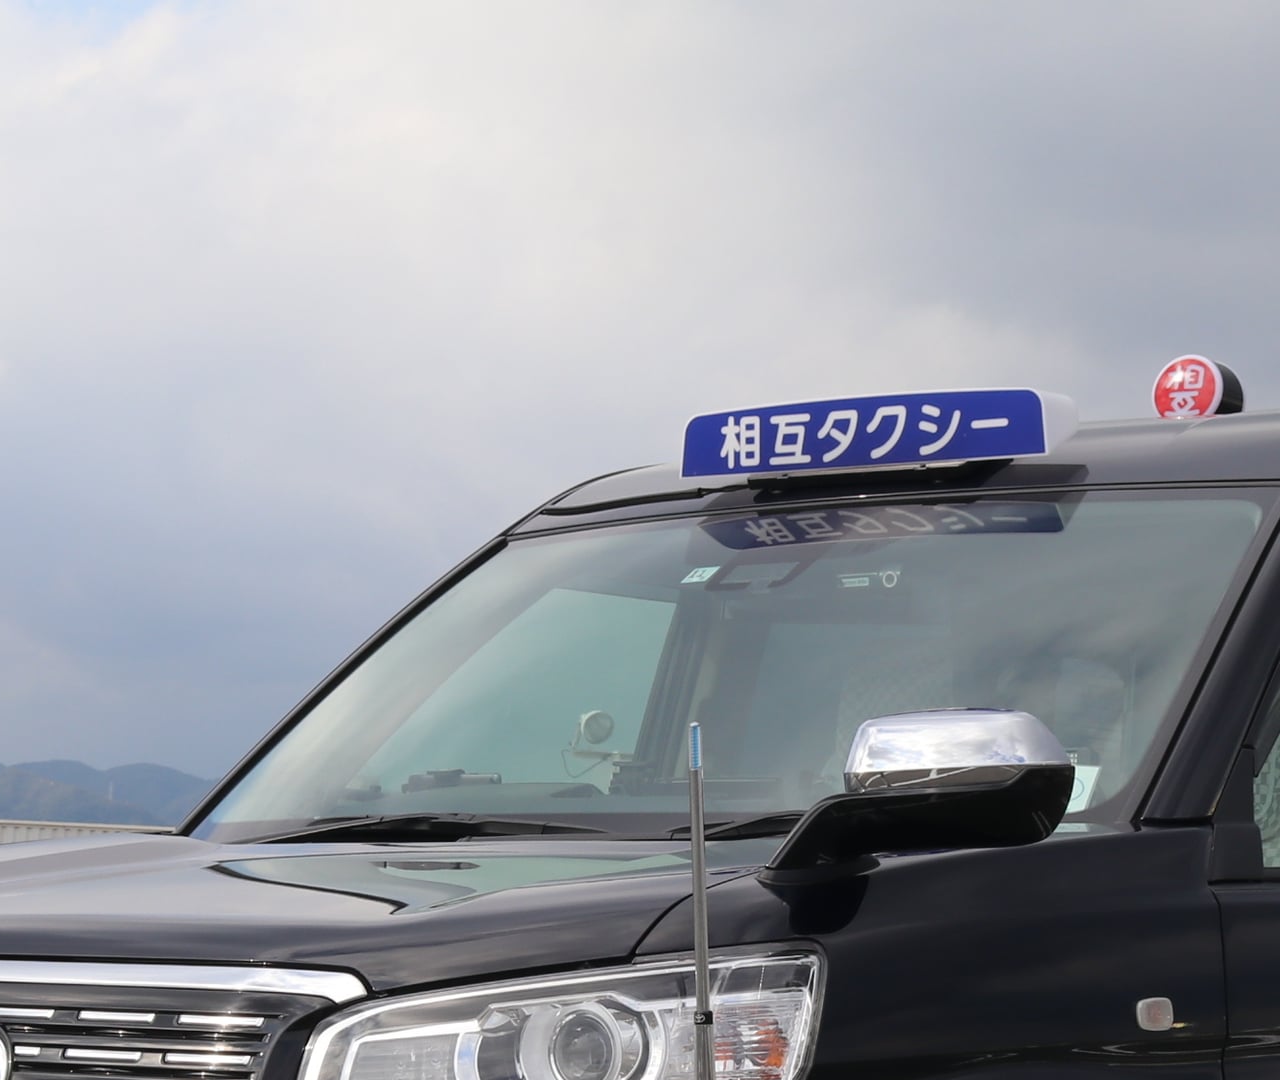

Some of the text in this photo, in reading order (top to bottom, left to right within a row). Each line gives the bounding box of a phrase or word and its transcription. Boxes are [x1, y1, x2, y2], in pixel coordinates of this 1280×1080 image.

[719, 403, 1010, 470] 相互タクシー
